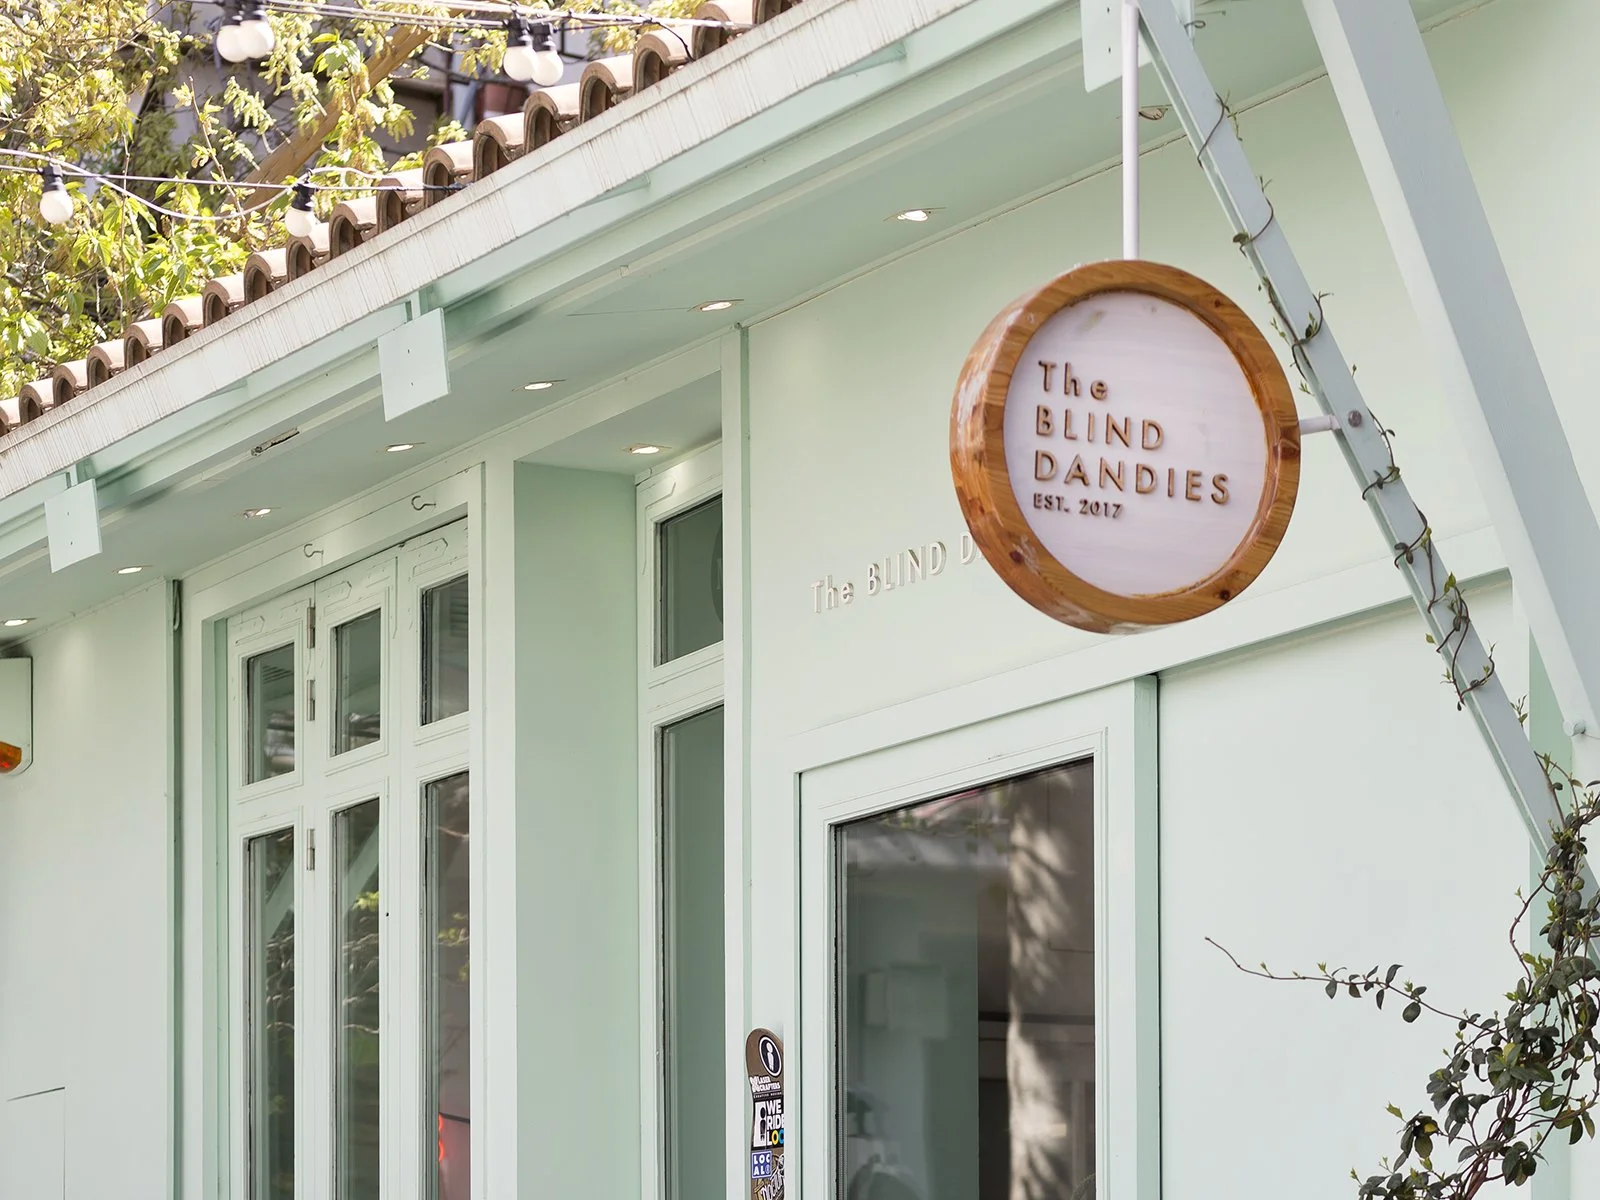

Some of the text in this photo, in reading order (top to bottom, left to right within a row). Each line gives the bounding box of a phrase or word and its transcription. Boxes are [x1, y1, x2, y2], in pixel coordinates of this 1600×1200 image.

[1038, 360, 1109, 400] The
[1035, 404, 1165, 451] BLIND
[1034, 450, 1231, 505] DANDIES
[1033, 492, 1124, 519] EST. 2017
[810, 574, 854, 613] The
[867, 541, 947, 596] BLIND
[766, 1099, 782, 1116] WE
